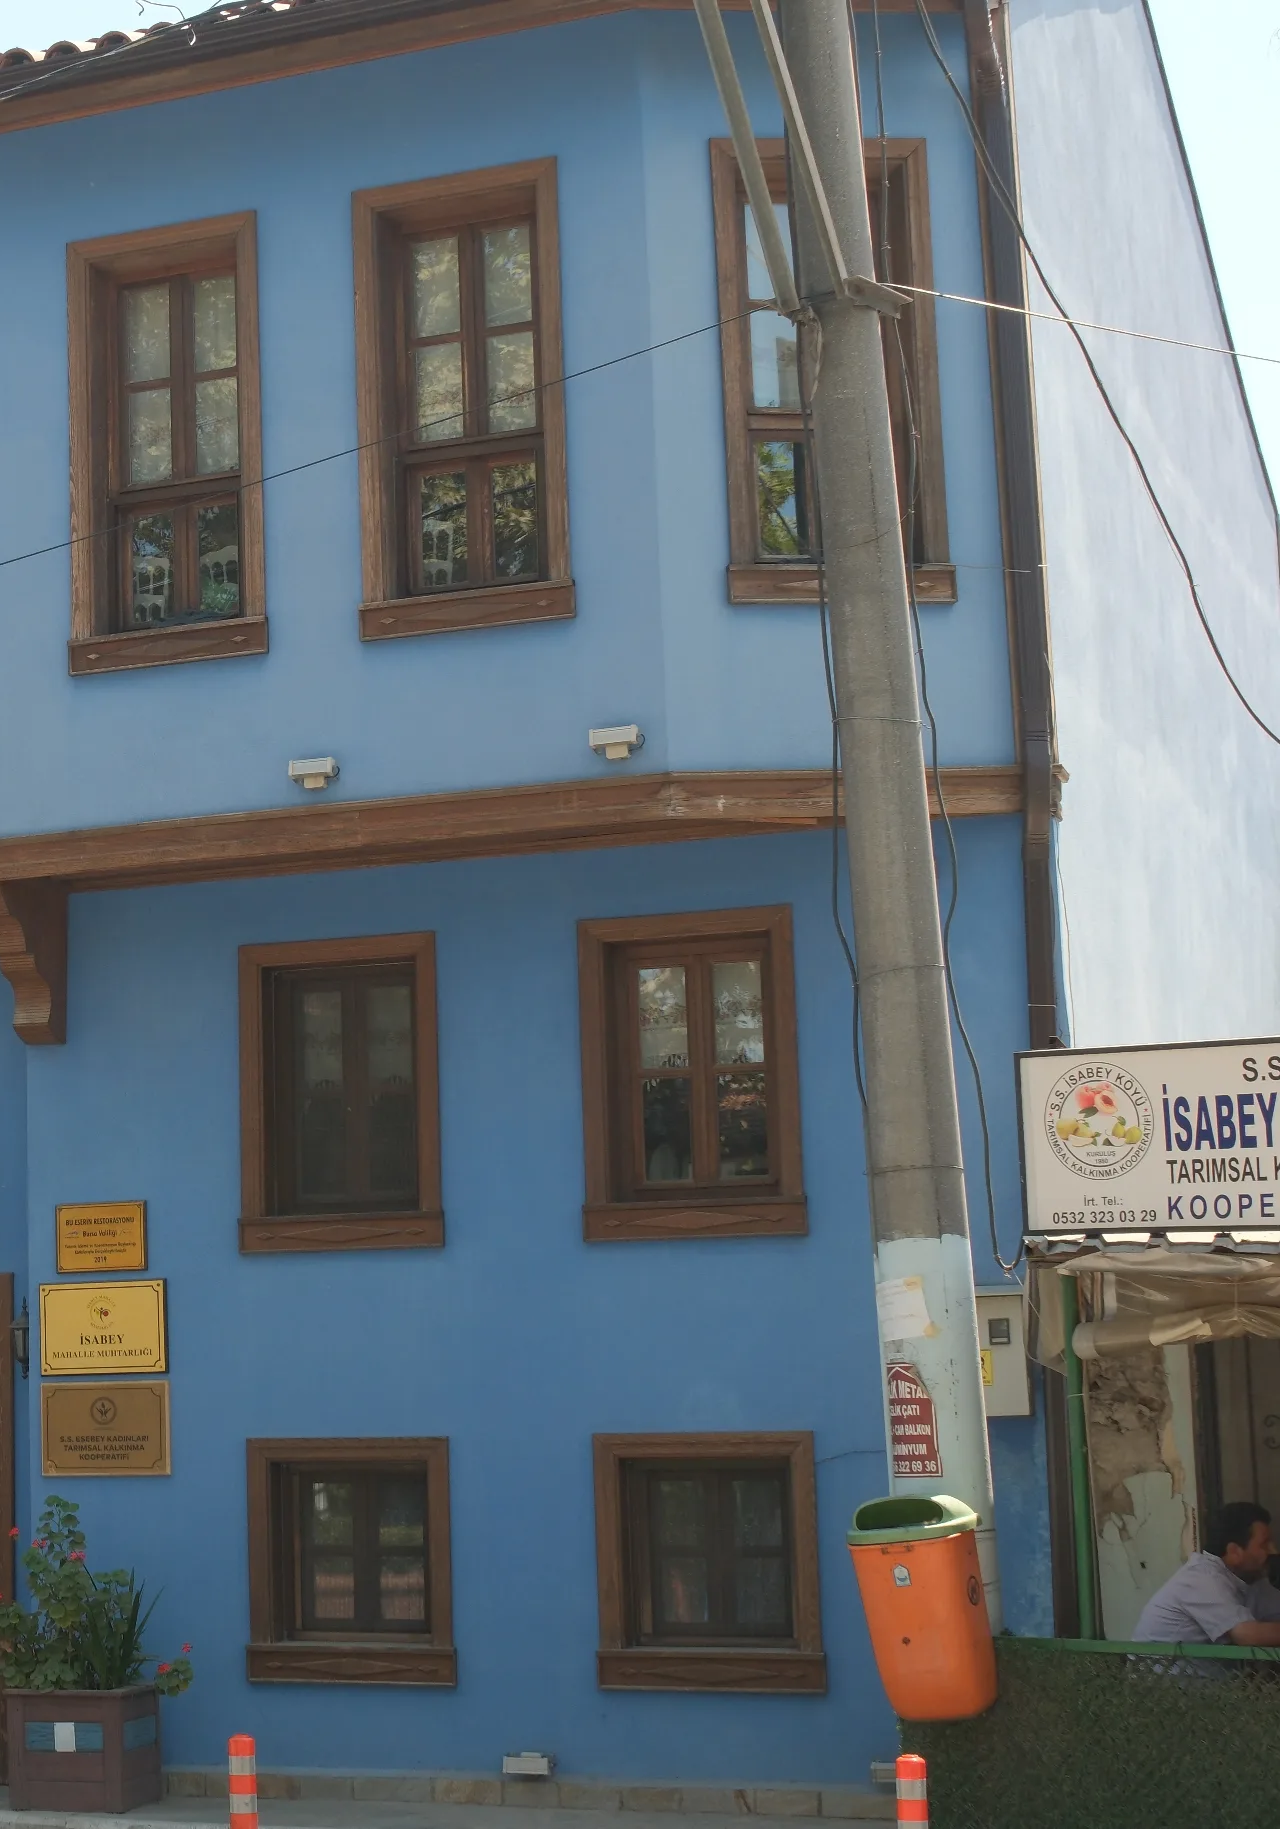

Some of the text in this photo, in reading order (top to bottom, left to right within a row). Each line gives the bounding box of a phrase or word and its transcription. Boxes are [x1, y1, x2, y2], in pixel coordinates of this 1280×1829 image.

[1050, 1066, 1148, 1112] S.S. İSABEY KÖYÜ
[1162, 1083, 1278, 1151] İSABEY
[1047, 1118, 1072, 1165] TARIMSAL
[1071, 1161, 1119, 1178] KALKINMA
[1166, 1156, 1268, 1184] TARIMSAL
[1053, 1209, 1157, 1224] 0532 323 03 29
[1167, 1193, 1276, 1220] KOOPE
[80, 1333, 125, 1345] İSABEY
[52, 1347, 153, 1359] MAHALLE MUHTARLIĞI
[64, 1444, 102, 1452] TARIMSAL
[911, 1461, 923, 1472] 69
[924, 1460, 937, 1472] 36
